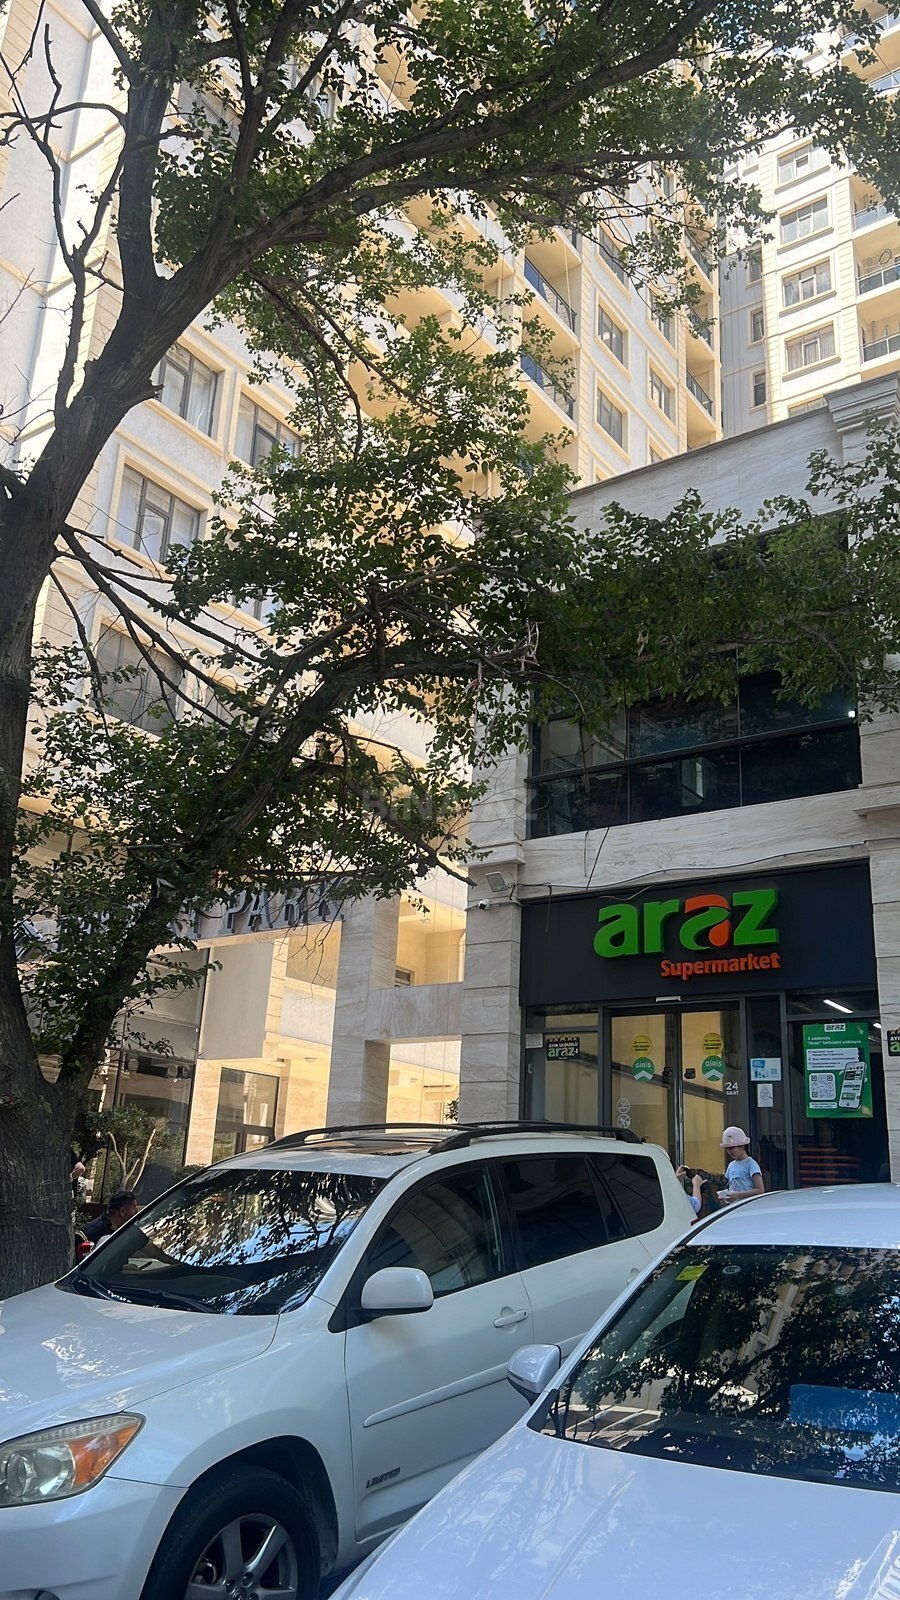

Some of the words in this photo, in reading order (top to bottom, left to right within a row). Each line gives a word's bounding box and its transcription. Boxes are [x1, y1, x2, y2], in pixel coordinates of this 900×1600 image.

[594, 889, 779, 958] araz
[661, 952, 781, 980] Supermarket
[726, 1082, 739, 1091] 24
